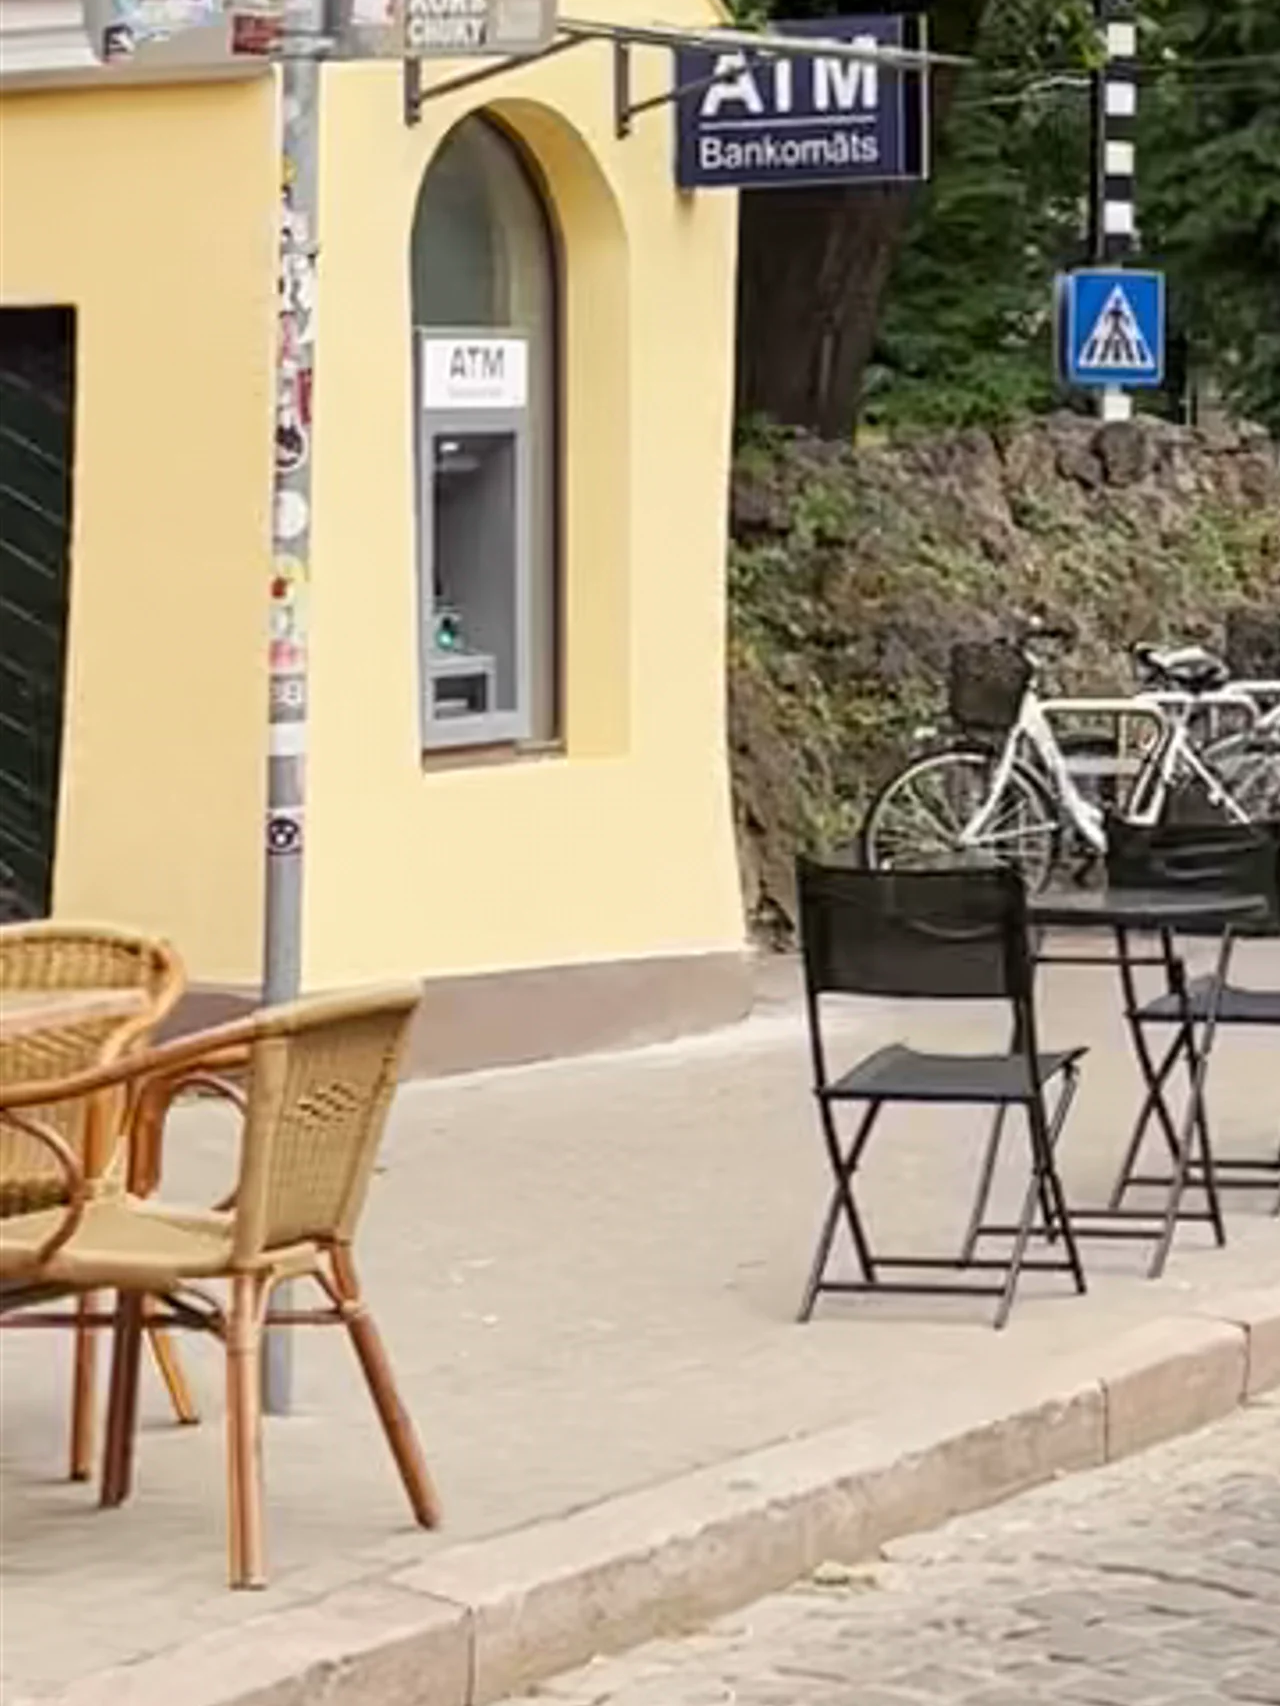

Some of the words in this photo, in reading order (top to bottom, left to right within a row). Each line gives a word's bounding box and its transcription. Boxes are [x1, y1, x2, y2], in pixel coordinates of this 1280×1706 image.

[701, 34, 878, 116] ATM
[701, 133, 879, 170] Bankomāts
[450, 346, 505, 379] ATM
